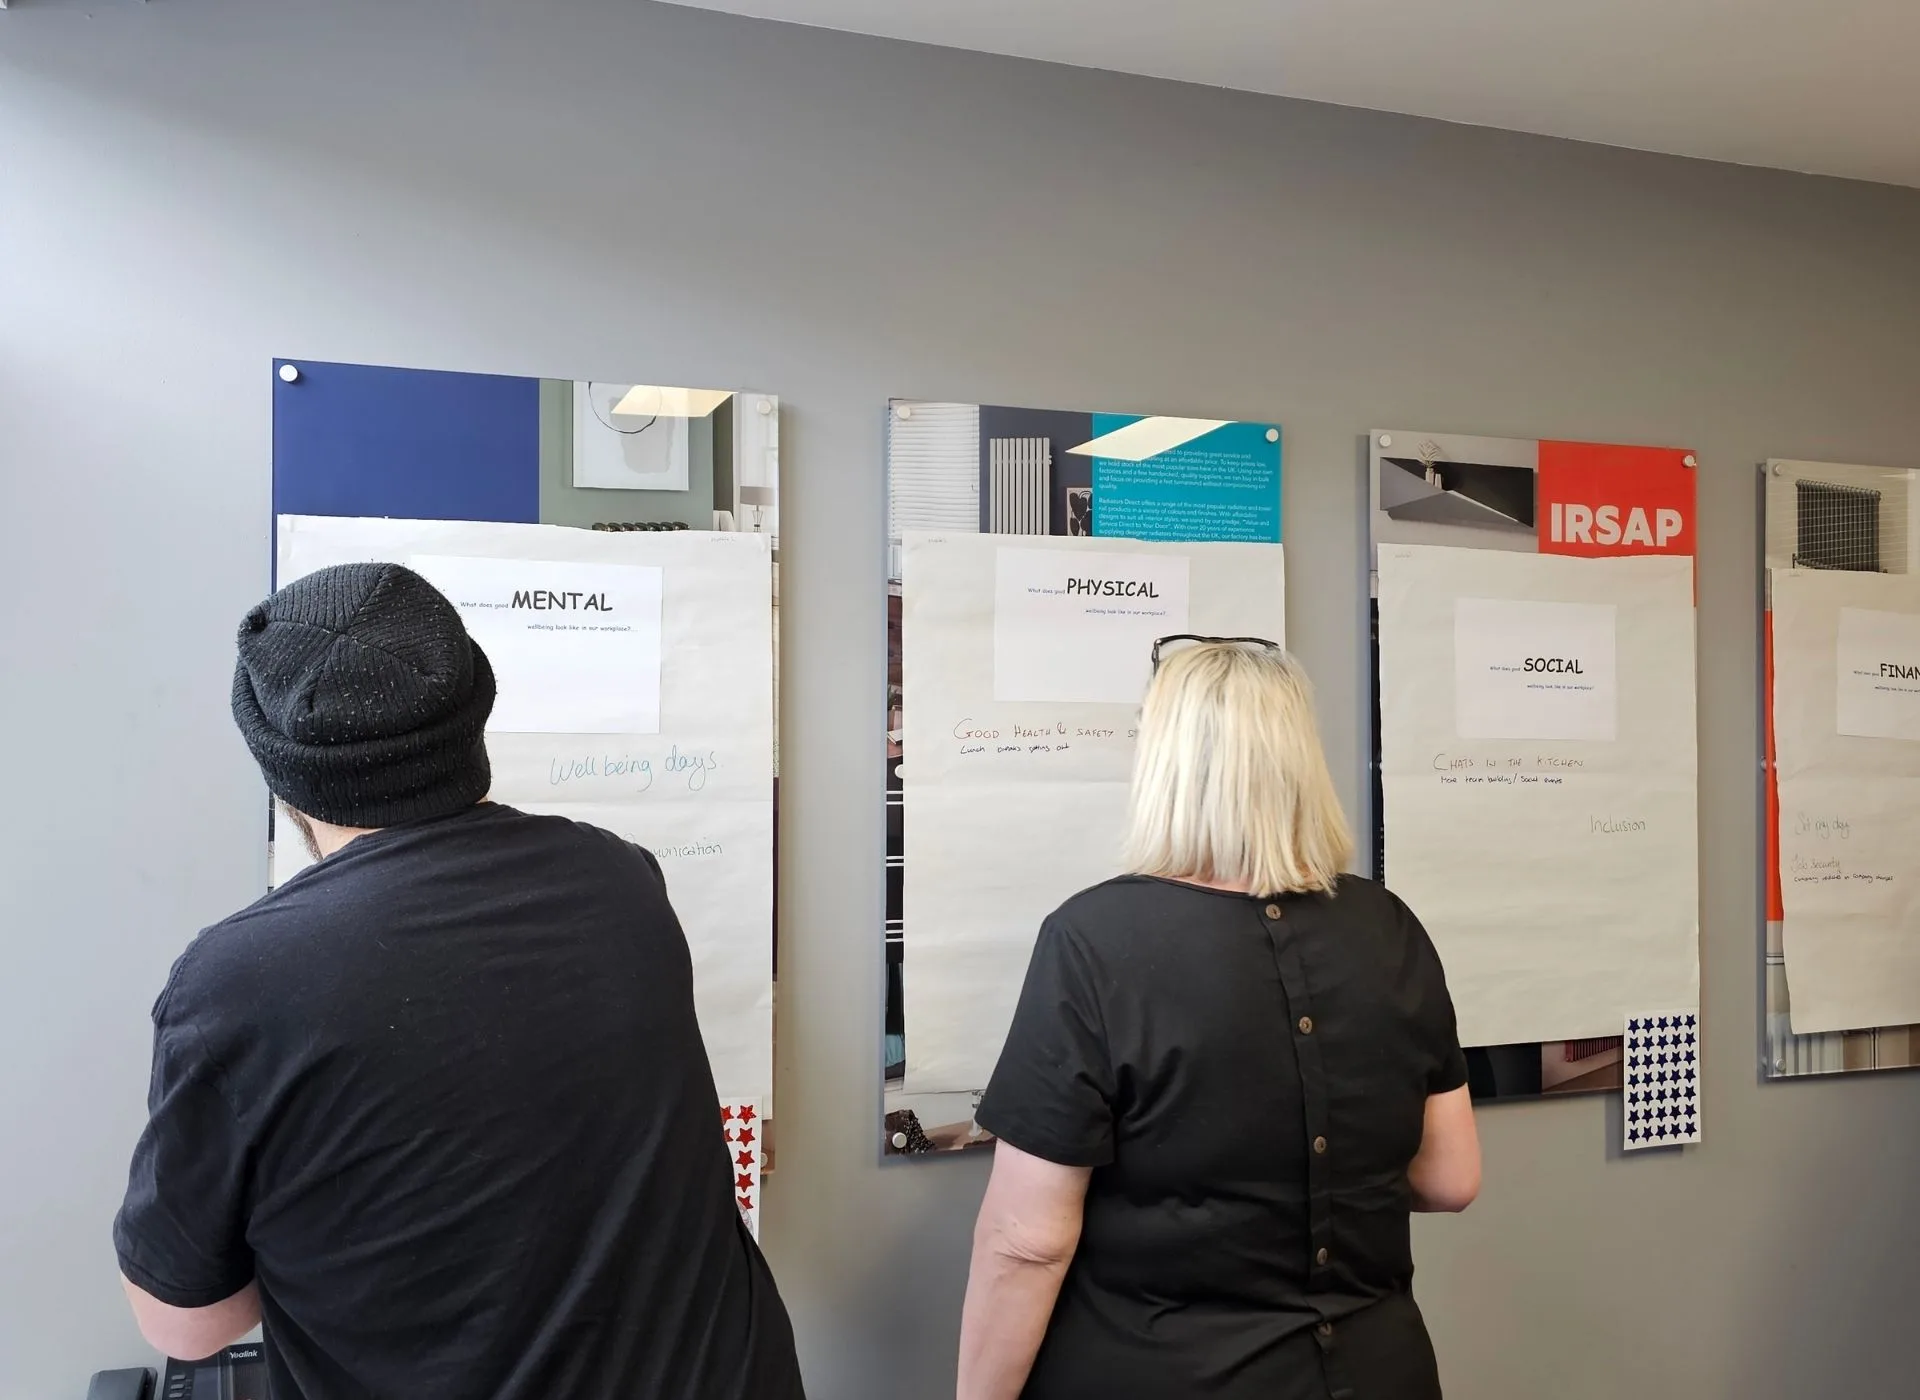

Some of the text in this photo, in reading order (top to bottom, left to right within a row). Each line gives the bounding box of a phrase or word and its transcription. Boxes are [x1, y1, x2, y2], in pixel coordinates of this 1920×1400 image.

[1551, 503, 1683, 547] IRSAP
[1066, 578, 1159, 598] PHYSICAL
[494, 602, 509, 610] good
[512, 590, 613, 612] MENTAL
[527, 624, 554, 632] wellbeing
[1523, 658, 1584, 674] SOCIAL
[1590, 814, 1646, 833] Inclusion
